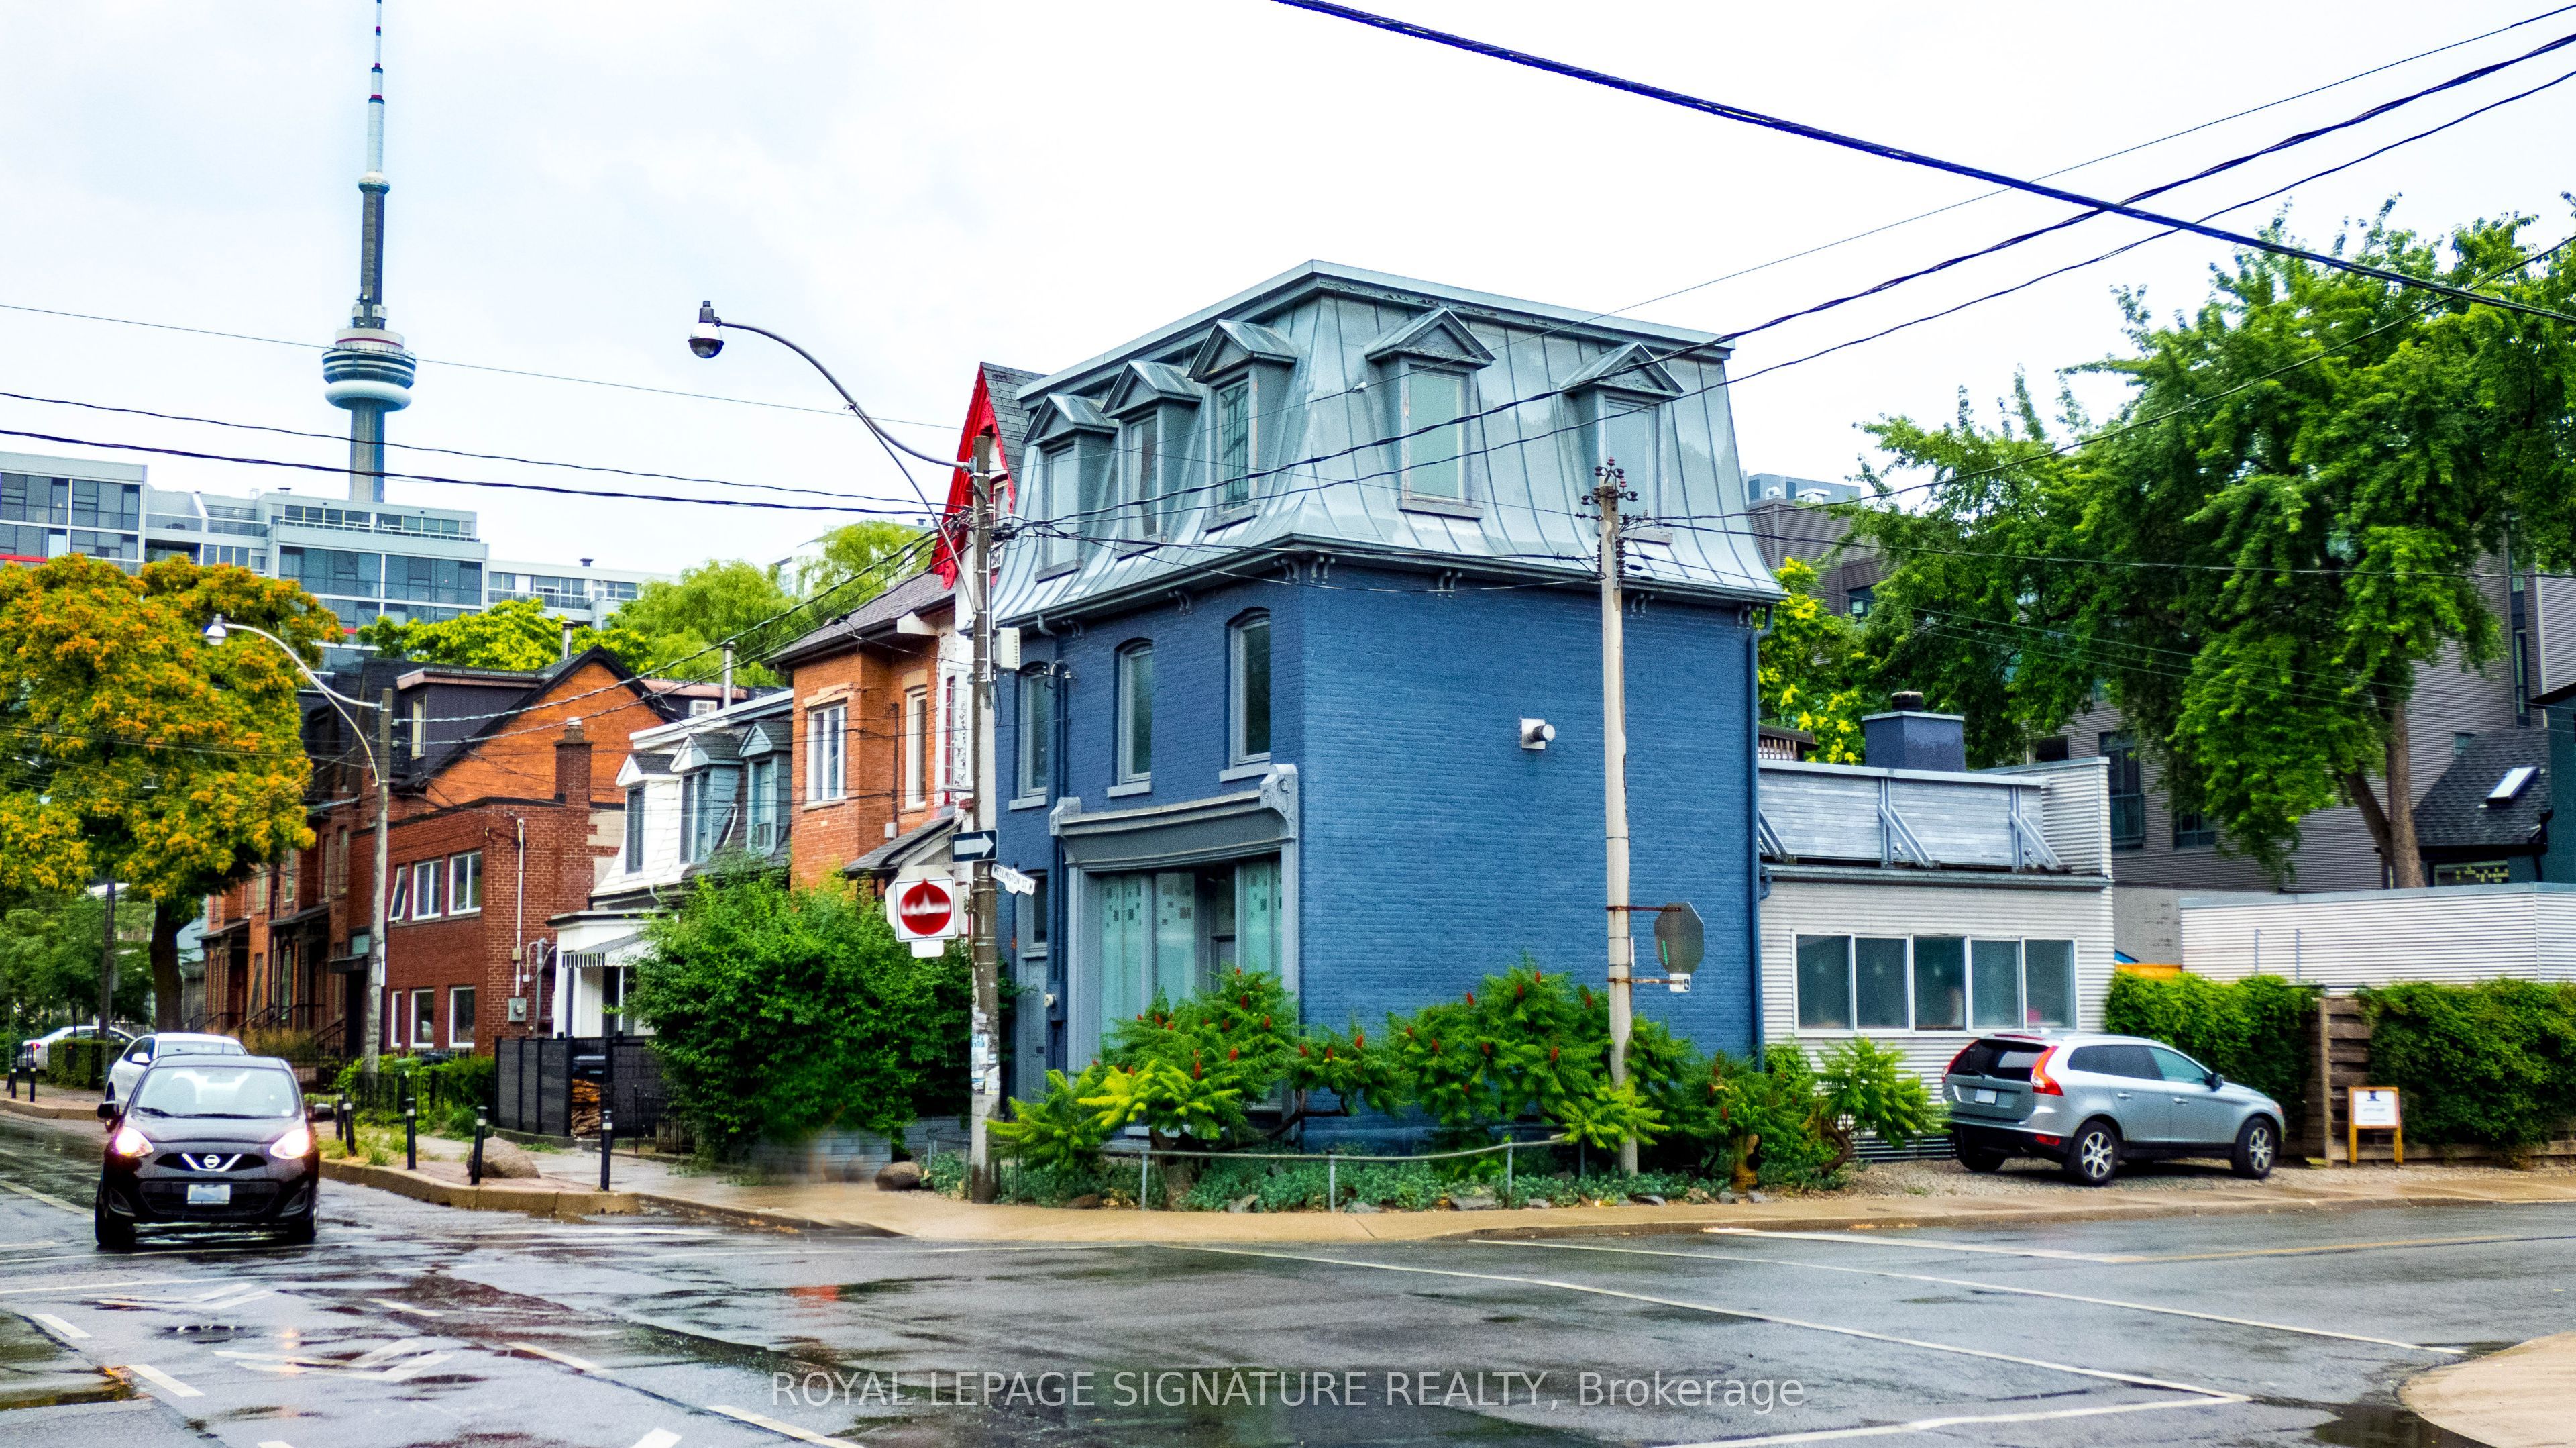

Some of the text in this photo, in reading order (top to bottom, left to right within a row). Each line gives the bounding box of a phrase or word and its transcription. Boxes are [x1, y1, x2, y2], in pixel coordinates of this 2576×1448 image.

[994, 865, 1020, 885] WELLINGTON
[1021, 878, 1028, 889] ST
[1028, 882, 1034, 892] W
